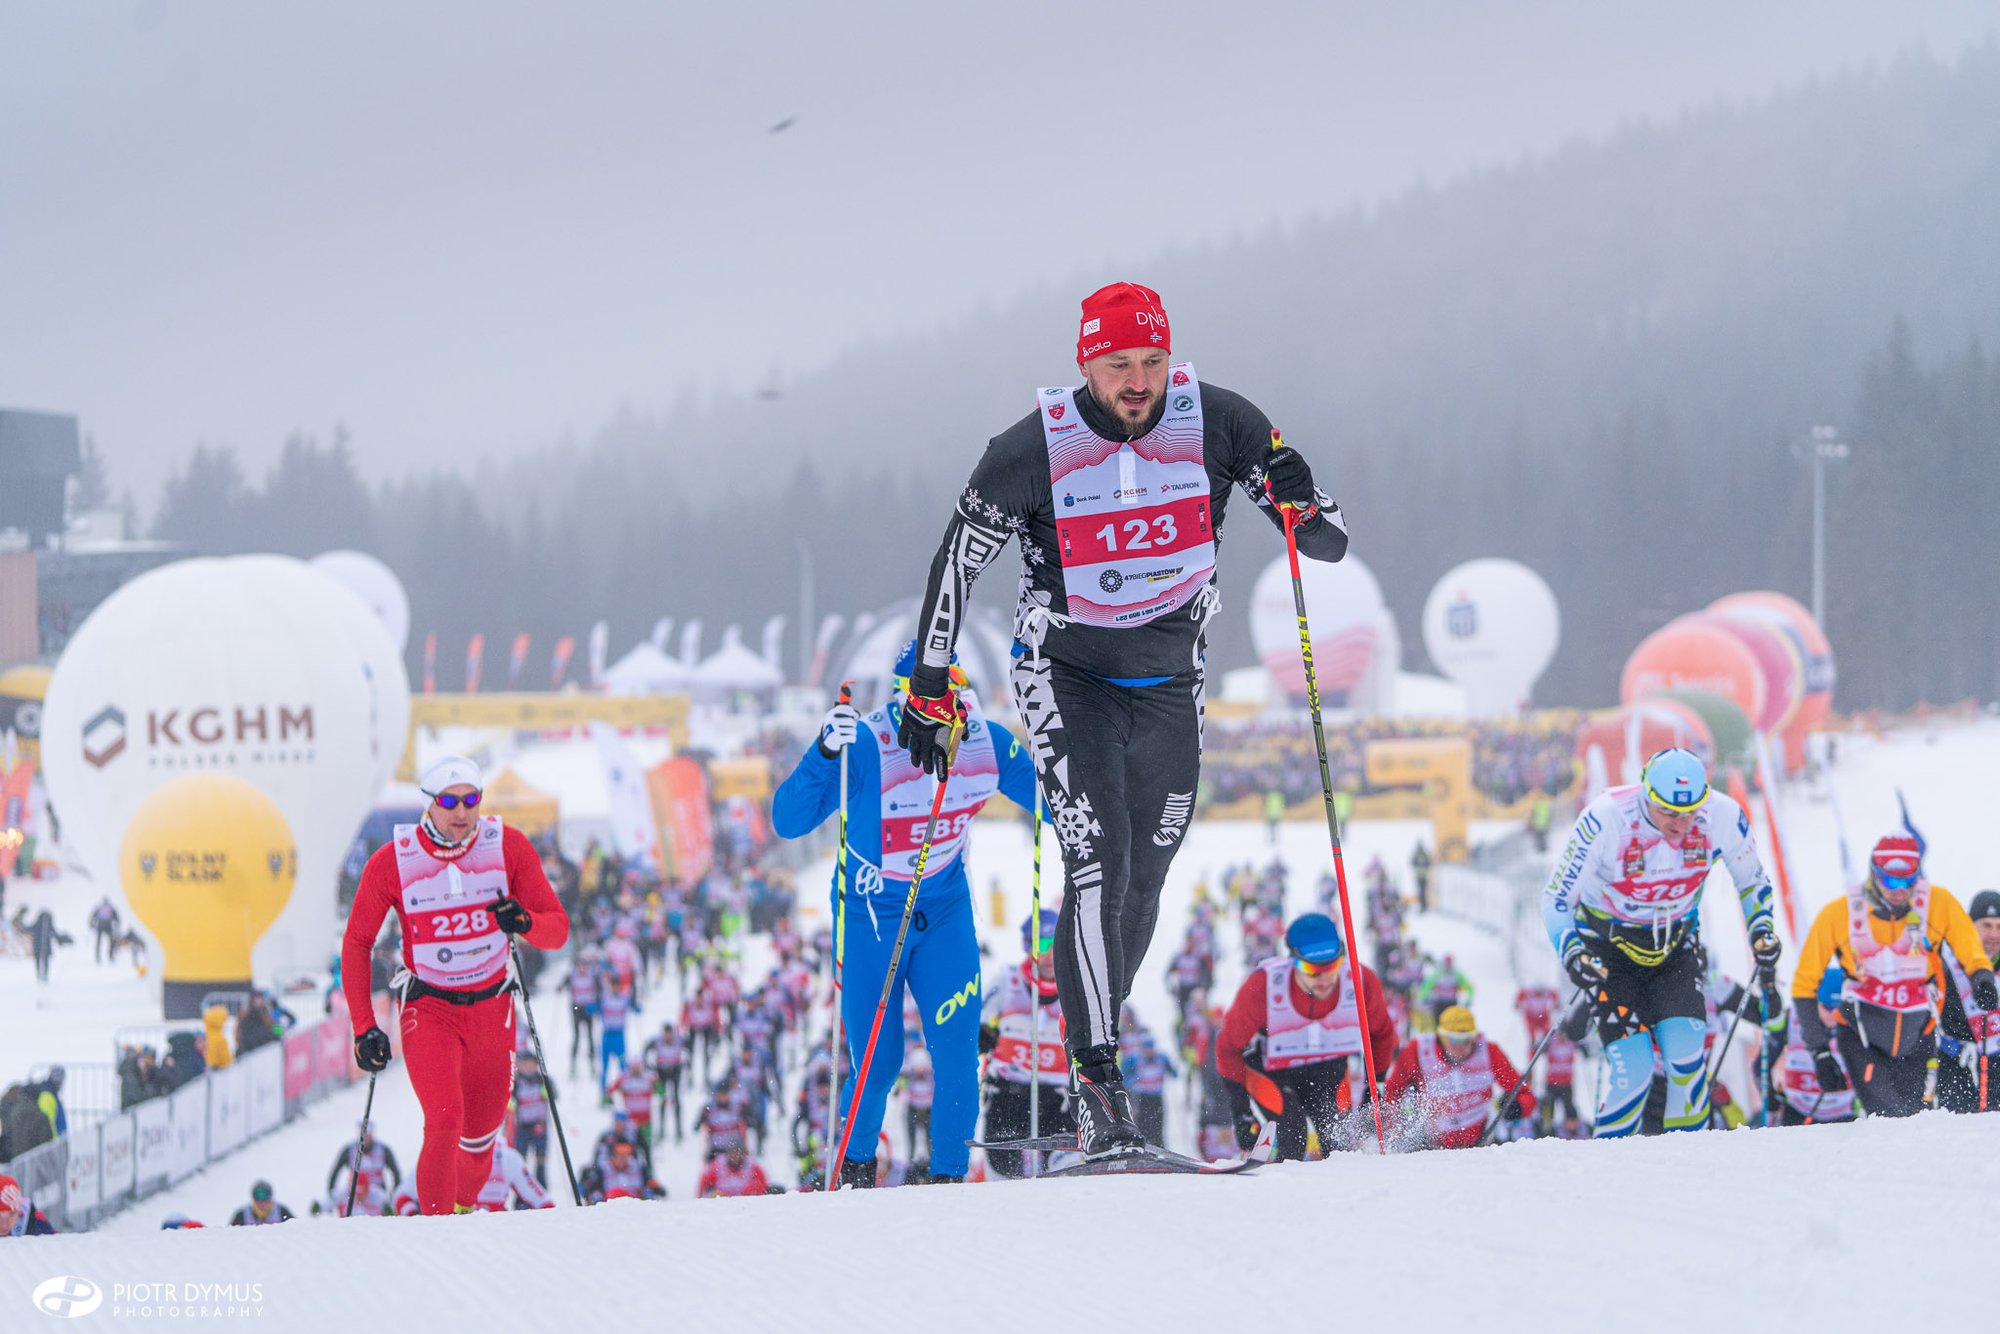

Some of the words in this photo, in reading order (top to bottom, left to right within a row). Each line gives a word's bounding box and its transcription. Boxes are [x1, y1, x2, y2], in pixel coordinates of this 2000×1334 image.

[1136, 305, 1166, 330] DNB
[1123, 487, 1148, 496] KGHM
[1171, 482, 1200, 491] TAURON
[1096, 514, 1178, 552] 123
[1297, 615, 1313, 662] LEKI
[147, 705, 315, 747] KGHM
[1160, 791, 1193, 827] SWIX
[916, 842, 932, 876] LEKI
[431, 909, 490, 938] 228
[935, 972, 979, 1026] OW
